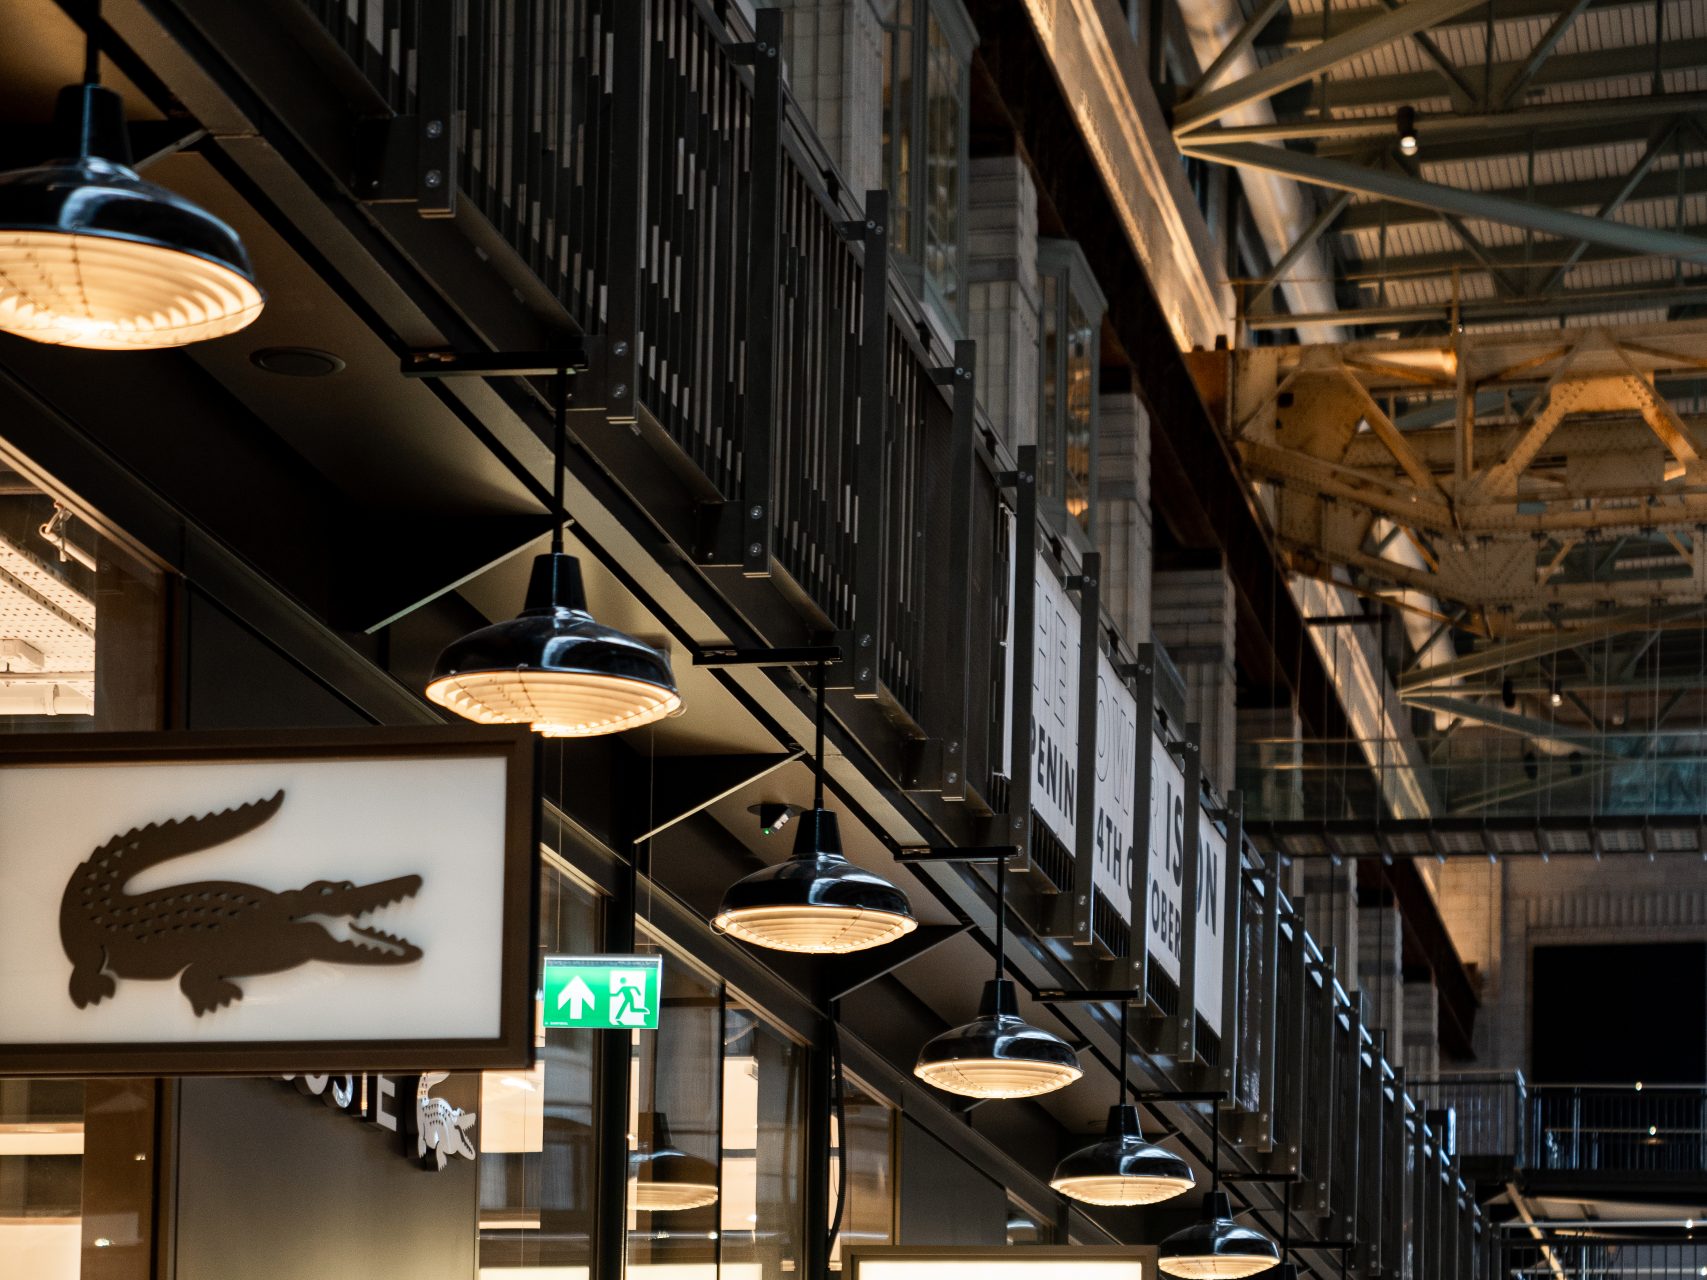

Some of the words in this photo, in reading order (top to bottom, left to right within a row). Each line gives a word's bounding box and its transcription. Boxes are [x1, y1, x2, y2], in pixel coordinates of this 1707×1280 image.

[1032, 578, 1067, 728] HE
[1165, 781, 1183, 887] IS
[1096, 807, 1122, 886] 4TH
